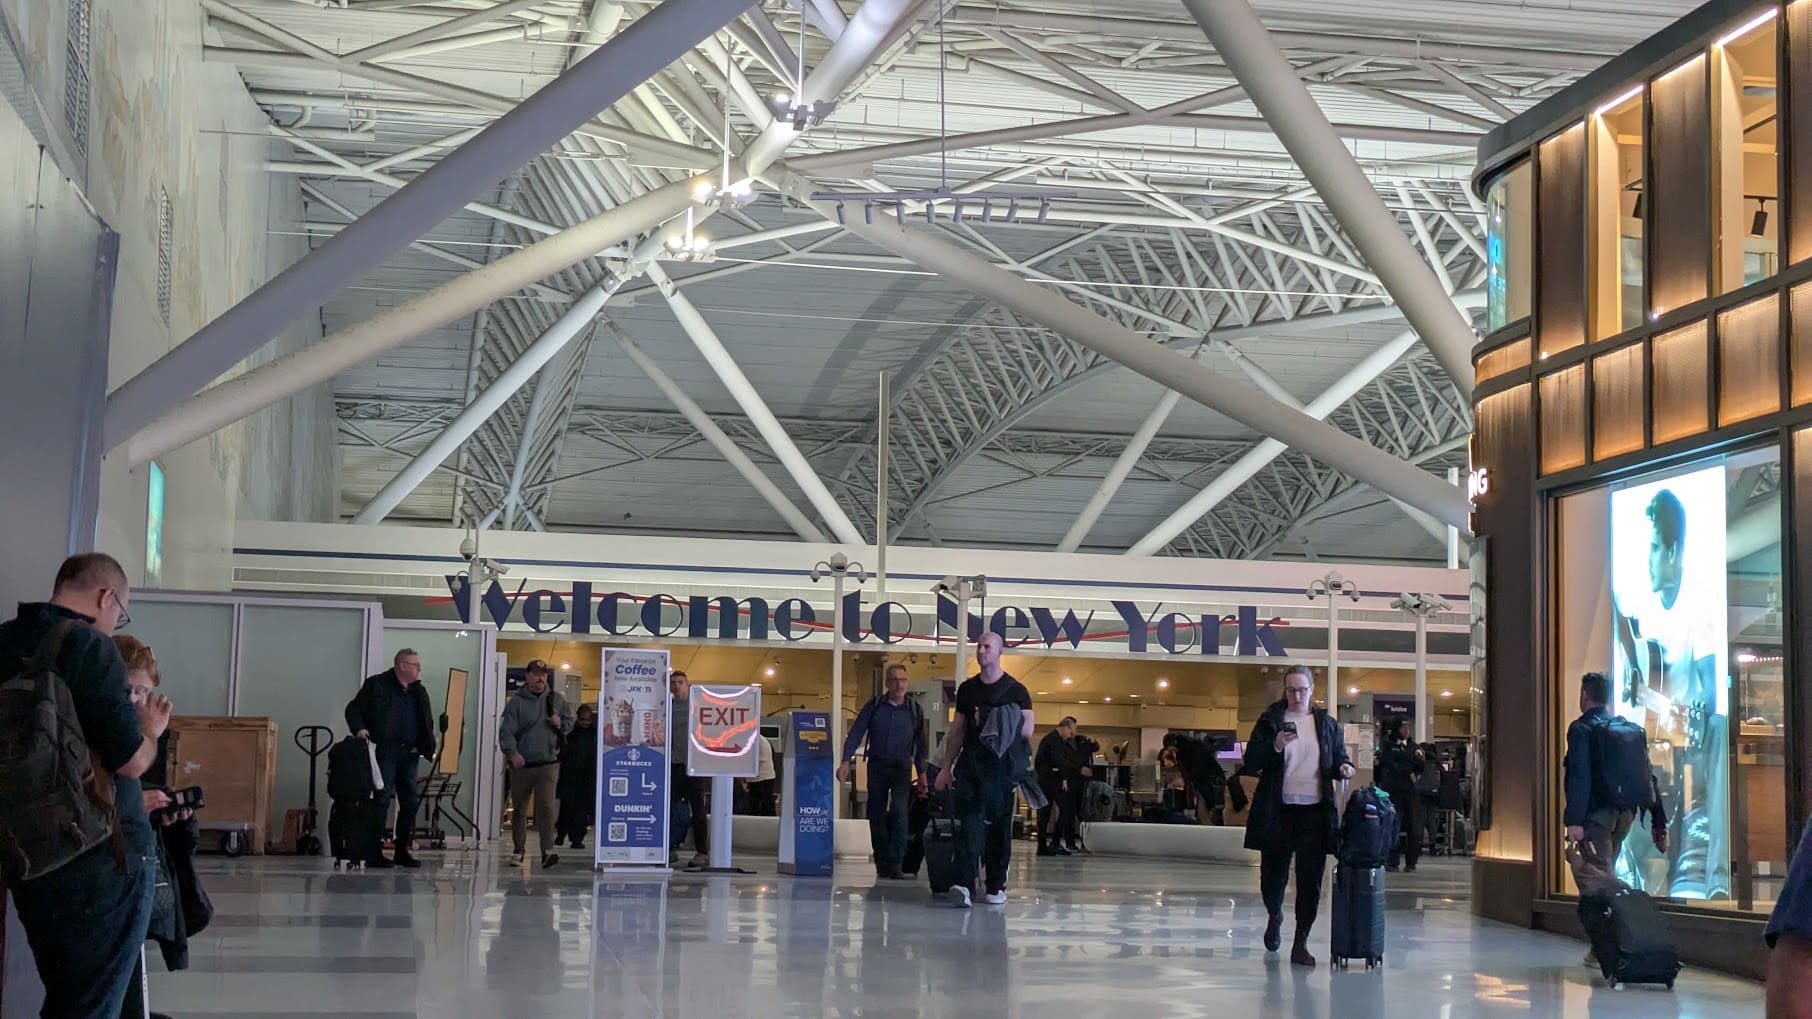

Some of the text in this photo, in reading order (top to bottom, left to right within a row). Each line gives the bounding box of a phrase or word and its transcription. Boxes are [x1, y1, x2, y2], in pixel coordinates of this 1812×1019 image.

[445, 575, 1289, 657] Welcome to New York
[615, 664, 657, 675] Coffee
[700, 707, 750, 726] EXIT
[614, 804, 652, 813] DUNKIN'
[800, 806, 820, 814] HOW
[800, 817, 829, 825] ARE WE
[800, 824, 831, 833] DOING?
